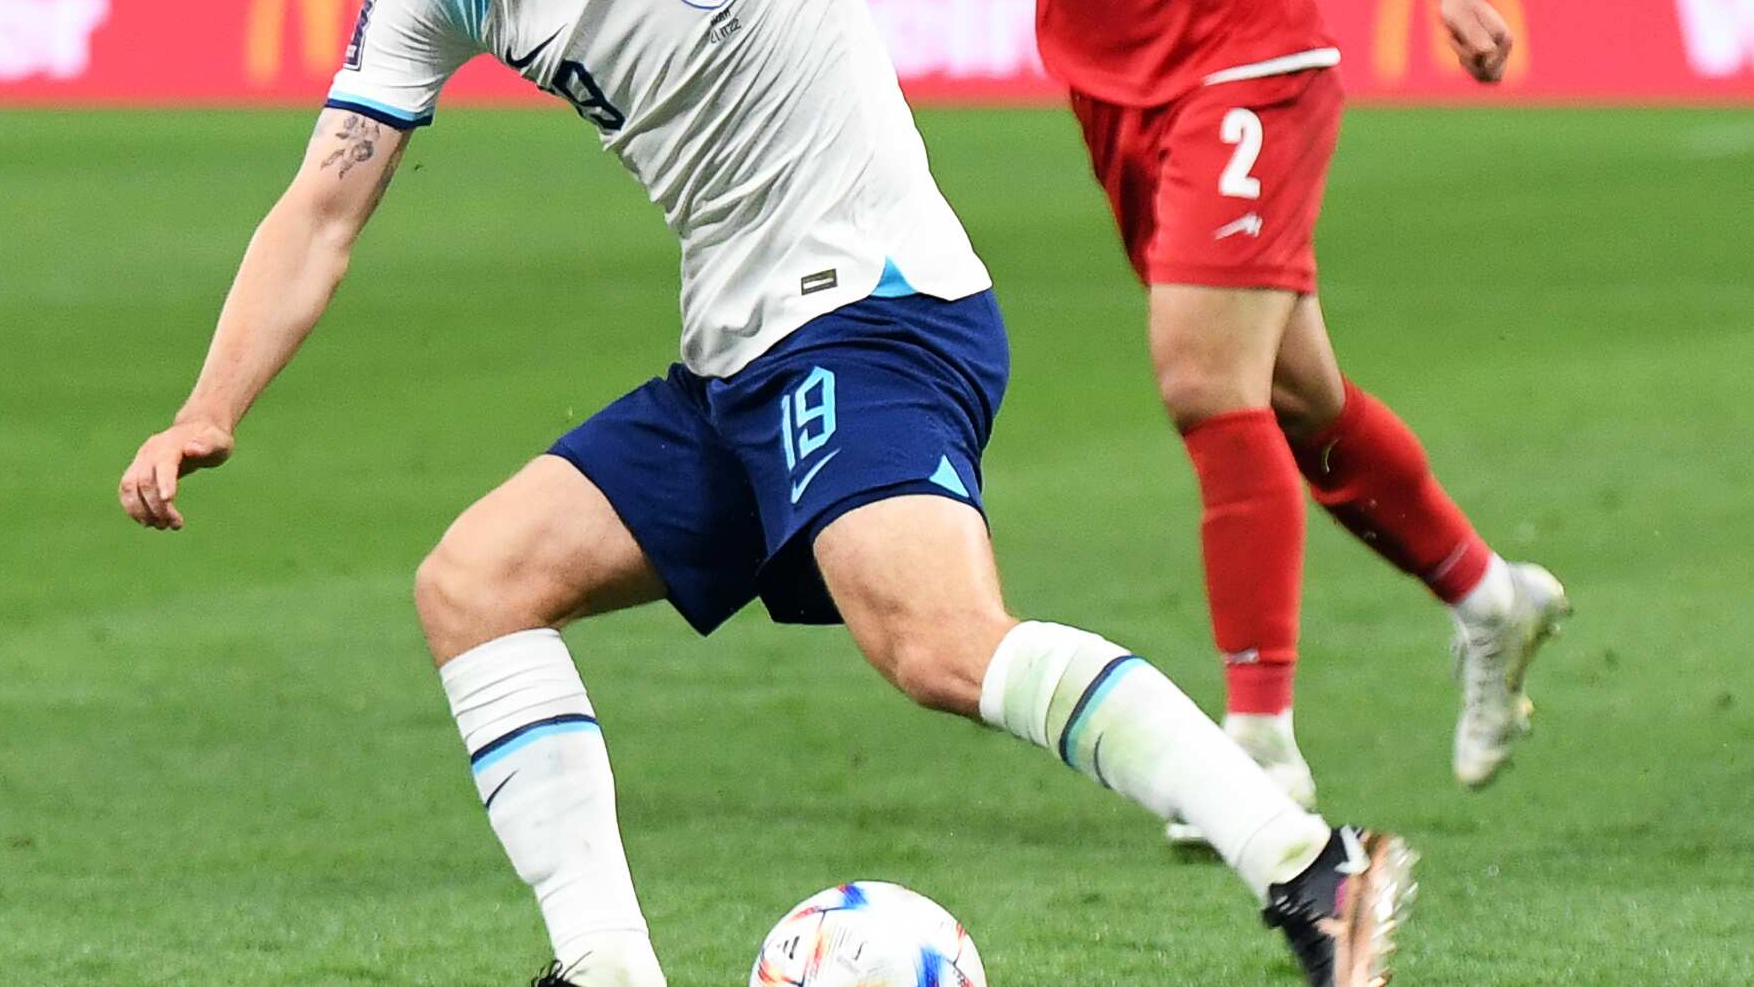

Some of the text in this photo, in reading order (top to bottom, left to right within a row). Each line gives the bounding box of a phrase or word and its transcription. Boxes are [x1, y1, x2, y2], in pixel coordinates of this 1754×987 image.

[537, 59, 625, 131] 9
[1219, 107, 1263, 198] 2
[782, 366, 836, 471] 19
